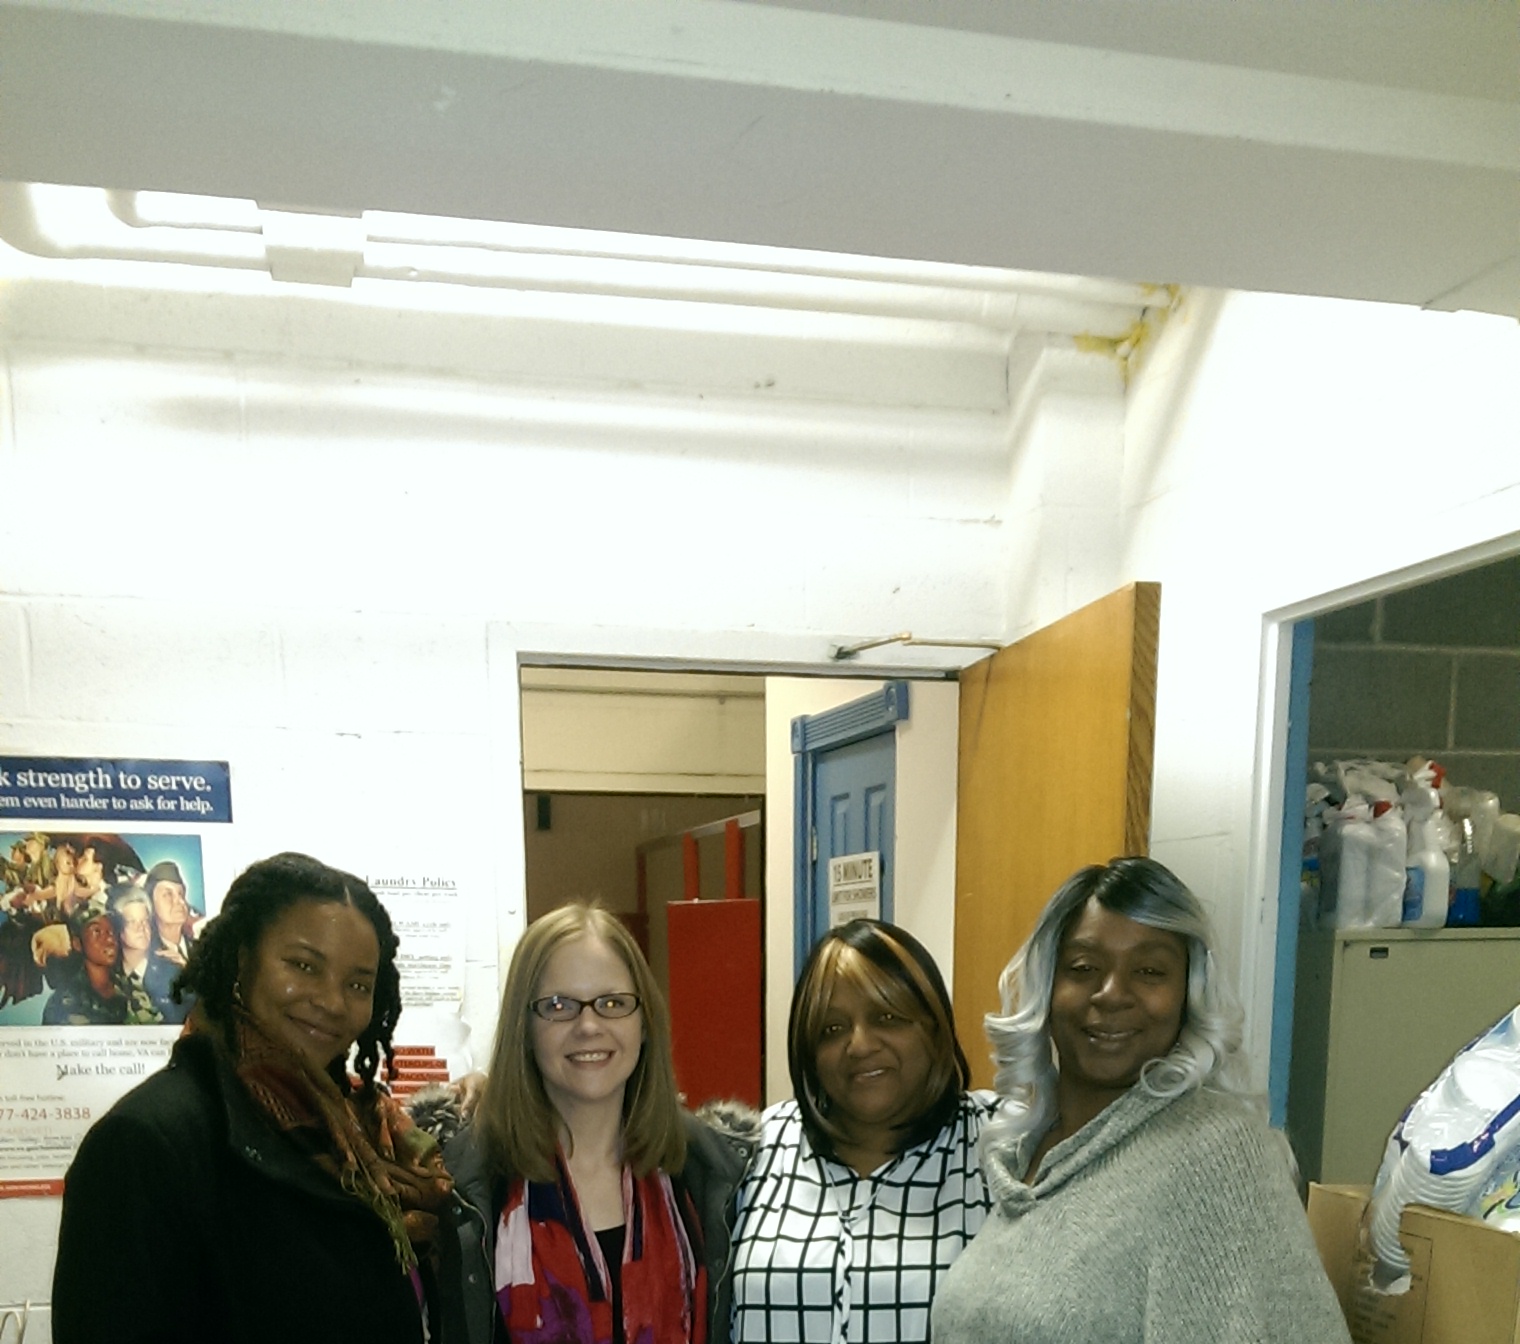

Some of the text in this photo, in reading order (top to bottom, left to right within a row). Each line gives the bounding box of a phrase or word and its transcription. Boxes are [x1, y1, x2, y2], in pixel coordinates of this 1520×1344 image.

[16, 768, 113, 793] strength
[119, 771, 141, 789] to
[147, 774, 212, 791] serve.
[23, 797, 57, 809] even
[60, 794, 108, 810] harder
[112, 796, 127, 810] to
[130, 795, 153, 811] ask
[157, 796, 177, 811] for
[180, 796, 214, 815] help.
[422, 876, 456, 888] Policy
[50, 1039, 67, 1047] U.S.
[56, 1062, 145, 1076] Make the call!
